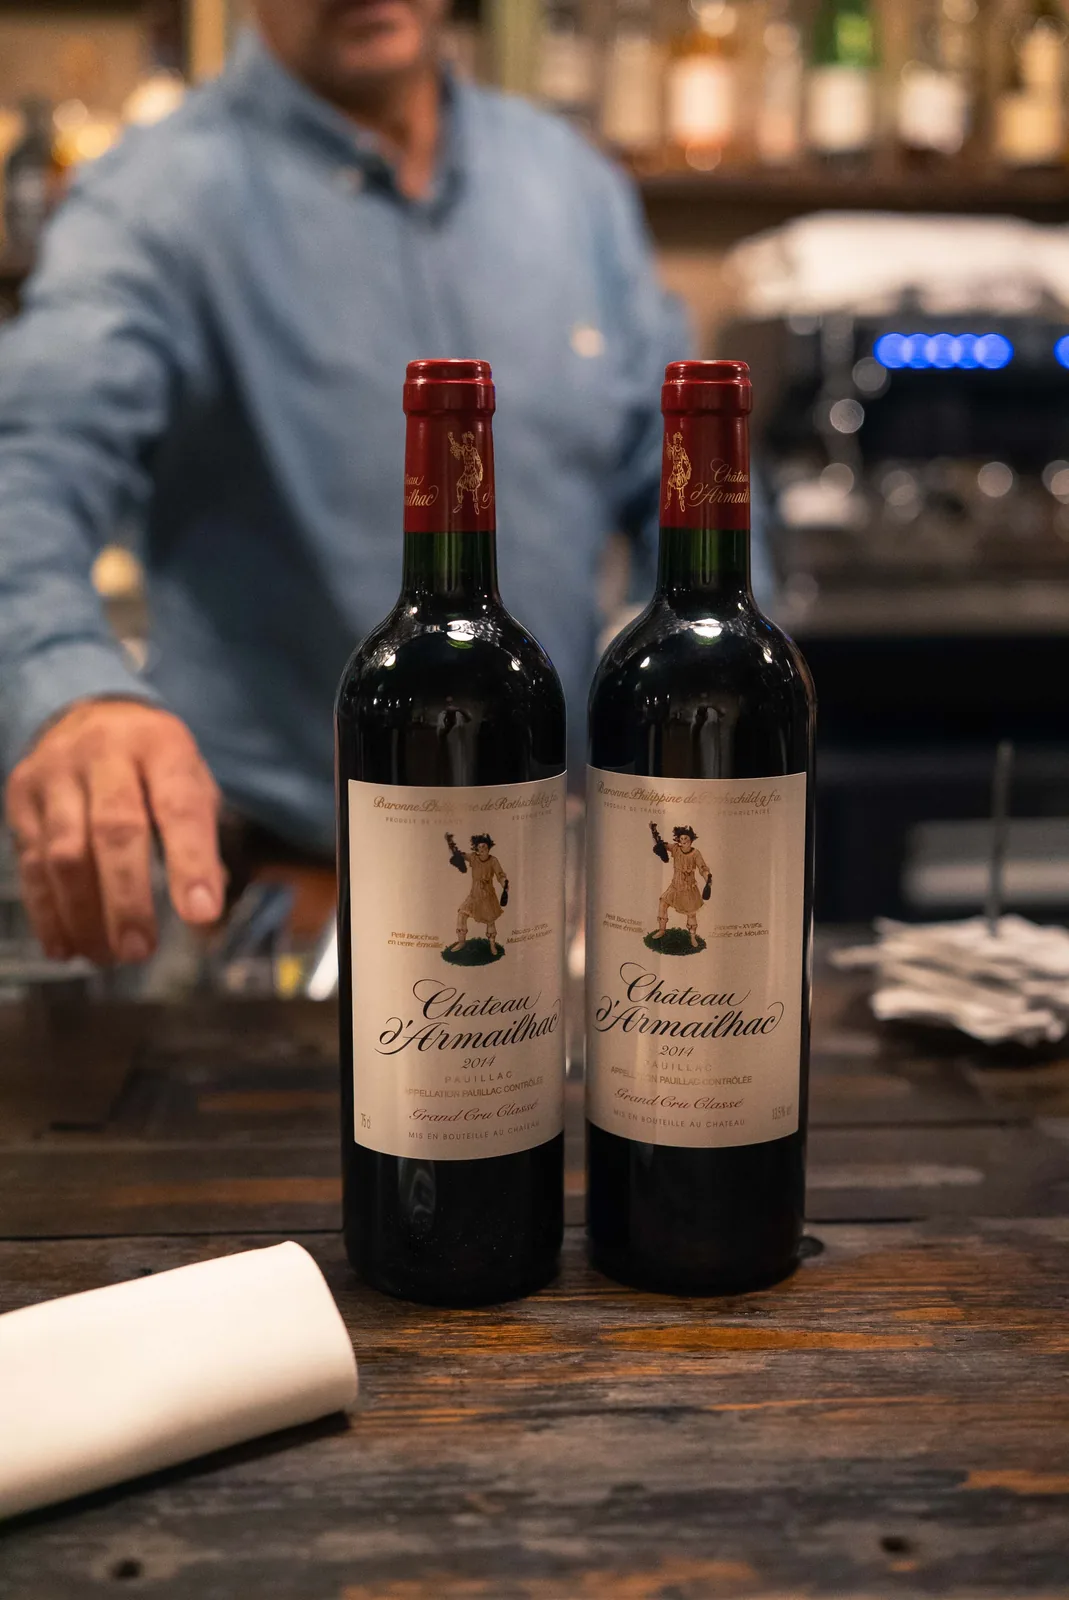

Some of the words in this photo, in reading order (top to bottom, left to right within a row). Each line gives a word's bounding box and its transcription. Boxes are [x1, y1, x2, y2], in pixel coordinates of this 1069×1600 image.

[373, 795, 421, 812] Baronne
[628, 787, 683, 806] Philippine
[683, 791, 698, 804] de
[619, 961, 751, 1007] Château
[412, 978, 542, 1020] Château
[592, 995, 785, 1039] d'Armailhac
[374, 998, 562, 1056] d'Armailhac
[659, 1044, 695, 1058] 2014
[461, 1055, 496, 1070] 2014
[444, 1070, 513, 1084] PAUILLAC
[462, 1087, 502, 1098] PAUILLAC
[614, 1087, 660, 1107] Grand
[660, 1095, 691, 1110] Cru
[693, 1096, 745, 1110] Classé
[408, 1107, 463, 1122] Grand
[464, 1107, 494, 1121] Cru
[496, 1100, 539, 1118] Classé
[628, 1112, 638, 1121] EN
[641, 1116, 686, 1128] BOUTEILLE
[690, 1120, 702, 1128] AU
[705, 1118, 745, 1128] CHATEAU
[408, 1131, 424, 1140] MIS
[427, 1132, 439, 1140] EN
[443, 1131, 489, 1140] BOUTEILLE
[493, 1129, 504, 1138] AU
